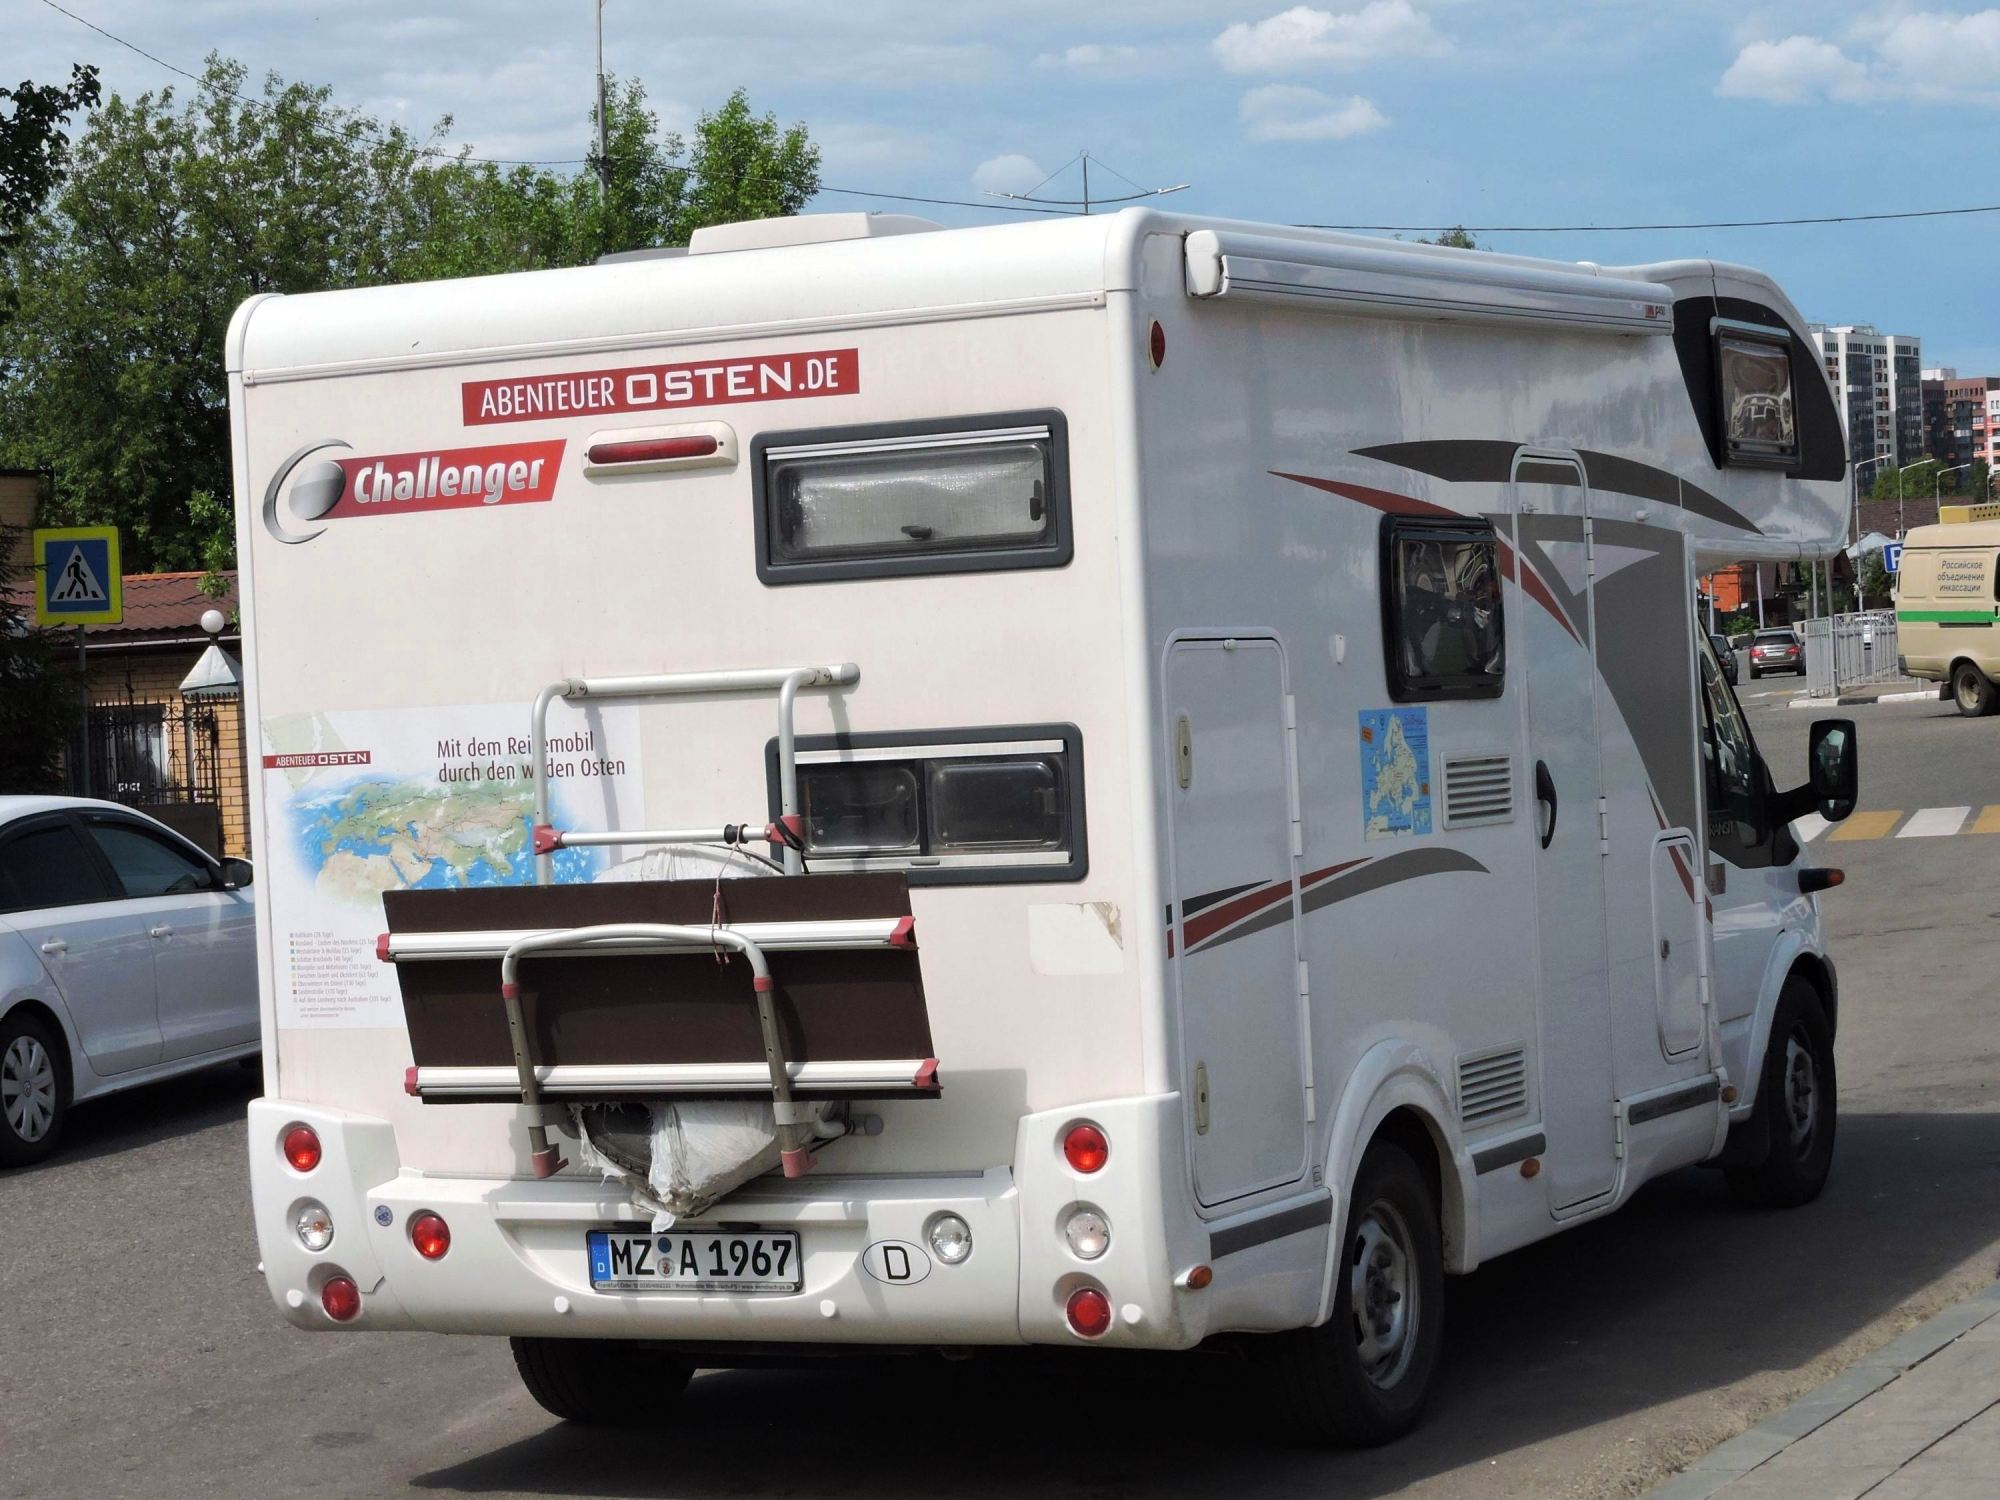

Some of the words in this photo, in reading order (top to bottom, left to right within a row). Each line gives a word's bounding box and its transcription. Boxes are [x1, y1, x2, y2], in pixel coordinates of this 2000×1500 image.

[480, 377, 615, 417] ABENTEUER
[625, 357, 840, 405] OSTEN.DE
[353, 456, 545, 504] Challenger
[1942, 560, 1983, 569] Российское
[1937, 572, 1985, 581] объединение
[1940, 584, 1981, 593] инкассации
[437, 740, 462, 758] Mit
[467, 736, 501, 757] dem
[275, 754, 316, 767] ABENTEUER
[318, 753, 368, 765] OSTEN
[439, 761, 480, 783] durch
[487, 760, 515, 781] den
[522, 757, 575, 779] wden
[581, 758, 625, 777] Osten
[597, 1262, 606, 1274] D
[611, 1239, 655, 1276] MZ
[679, 1239, 700, 1276] A
[708, 1239, 792, 1277] 1967
[883, 1245, 911, 1280] D
